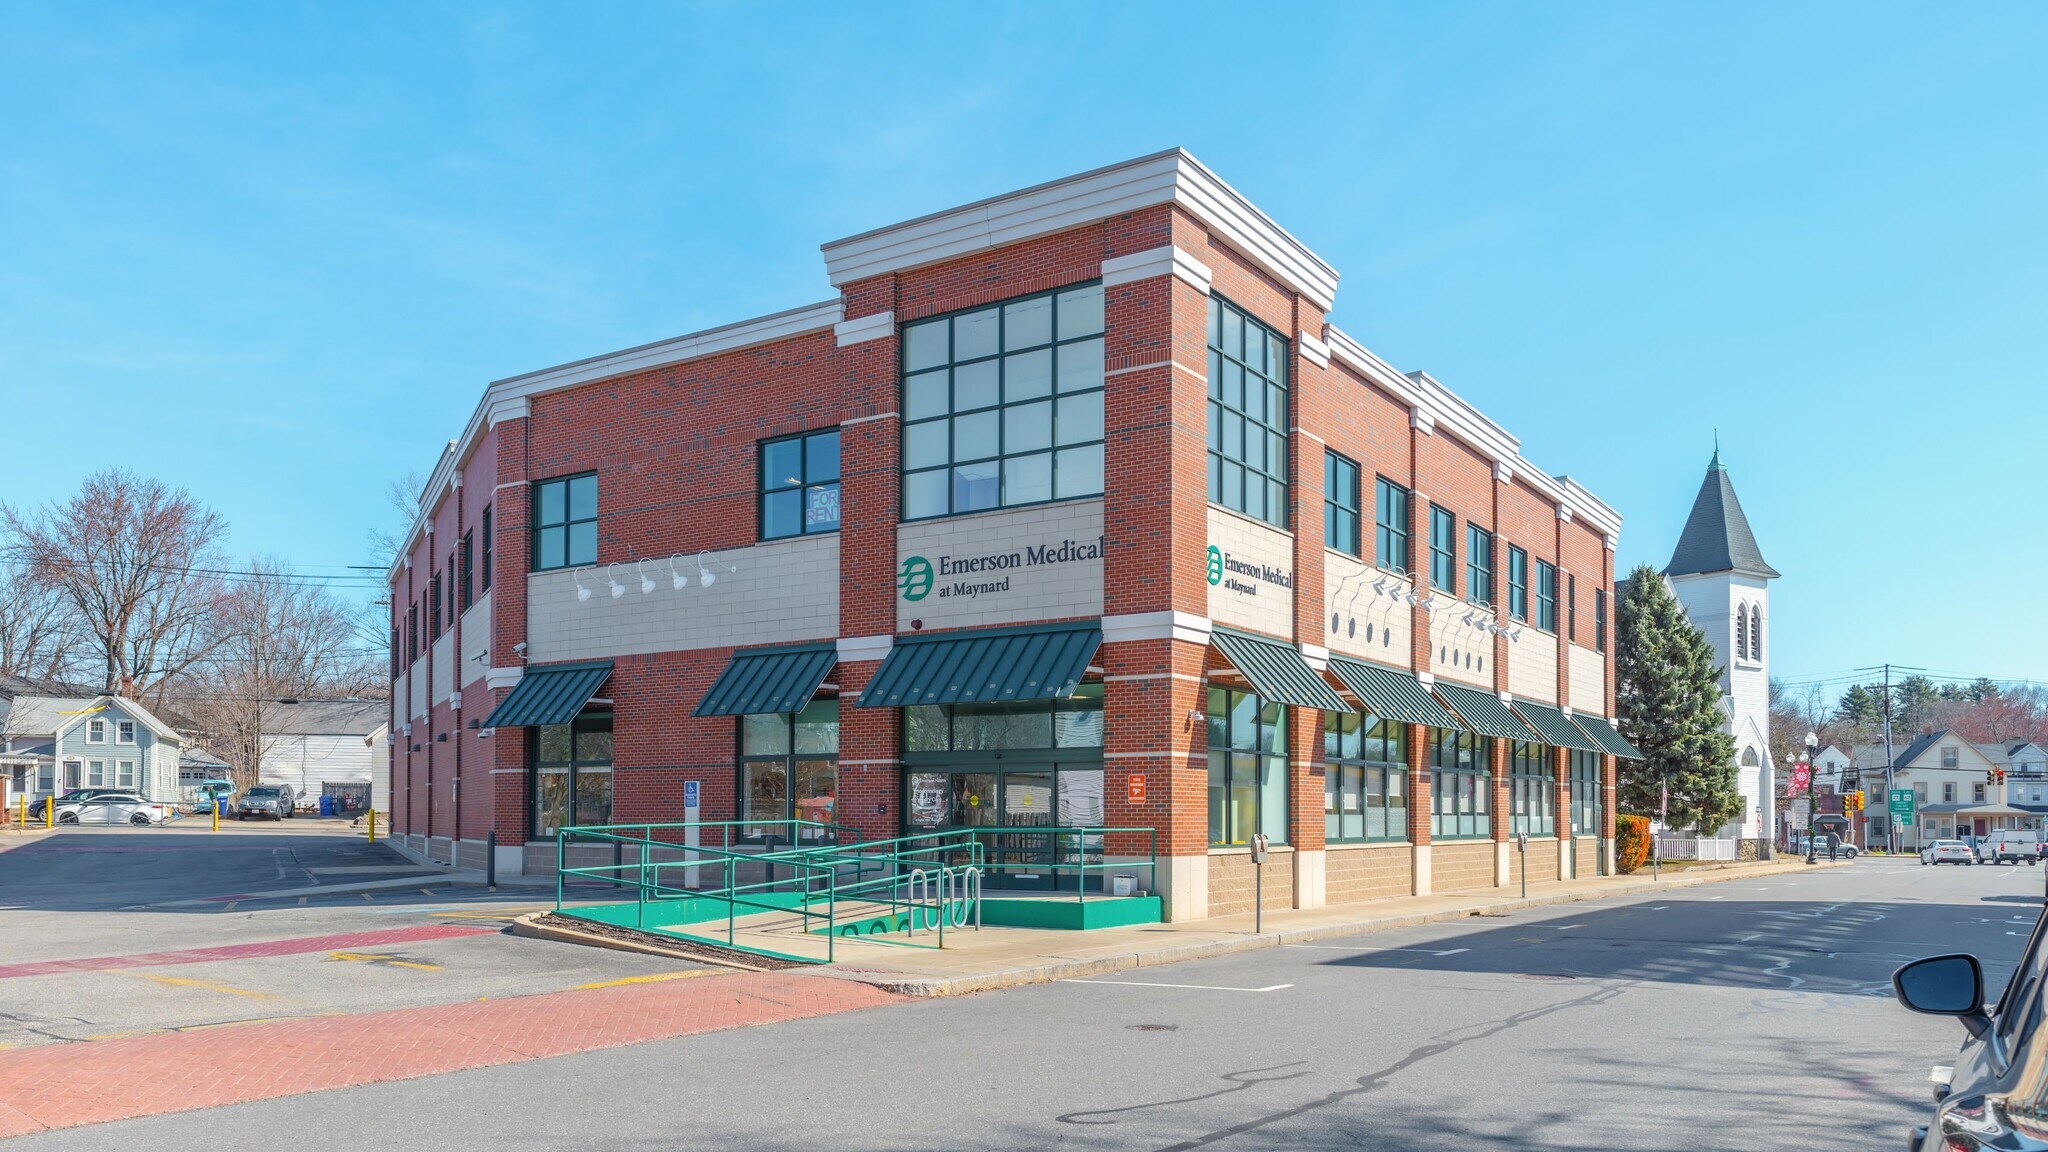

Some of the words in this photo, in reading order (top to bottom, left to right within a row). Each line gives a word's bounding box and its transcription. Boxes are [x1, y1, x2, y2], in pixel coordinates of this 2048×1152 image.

[811, 491, 837, 509] FOR
[939, 553, 1021, 576] Emerson
[1026, 536, 1105, 566] Medical
[1224, 553, 1261, 580] Emerson
[1262, 564, 1292, 589] Medical
[939, 586, 951, 597] at
[953, 576, 1010, 599] Maynard
[1224, 579, 1232, 588] at
[1231, 579, 1257, 596] Maynard
